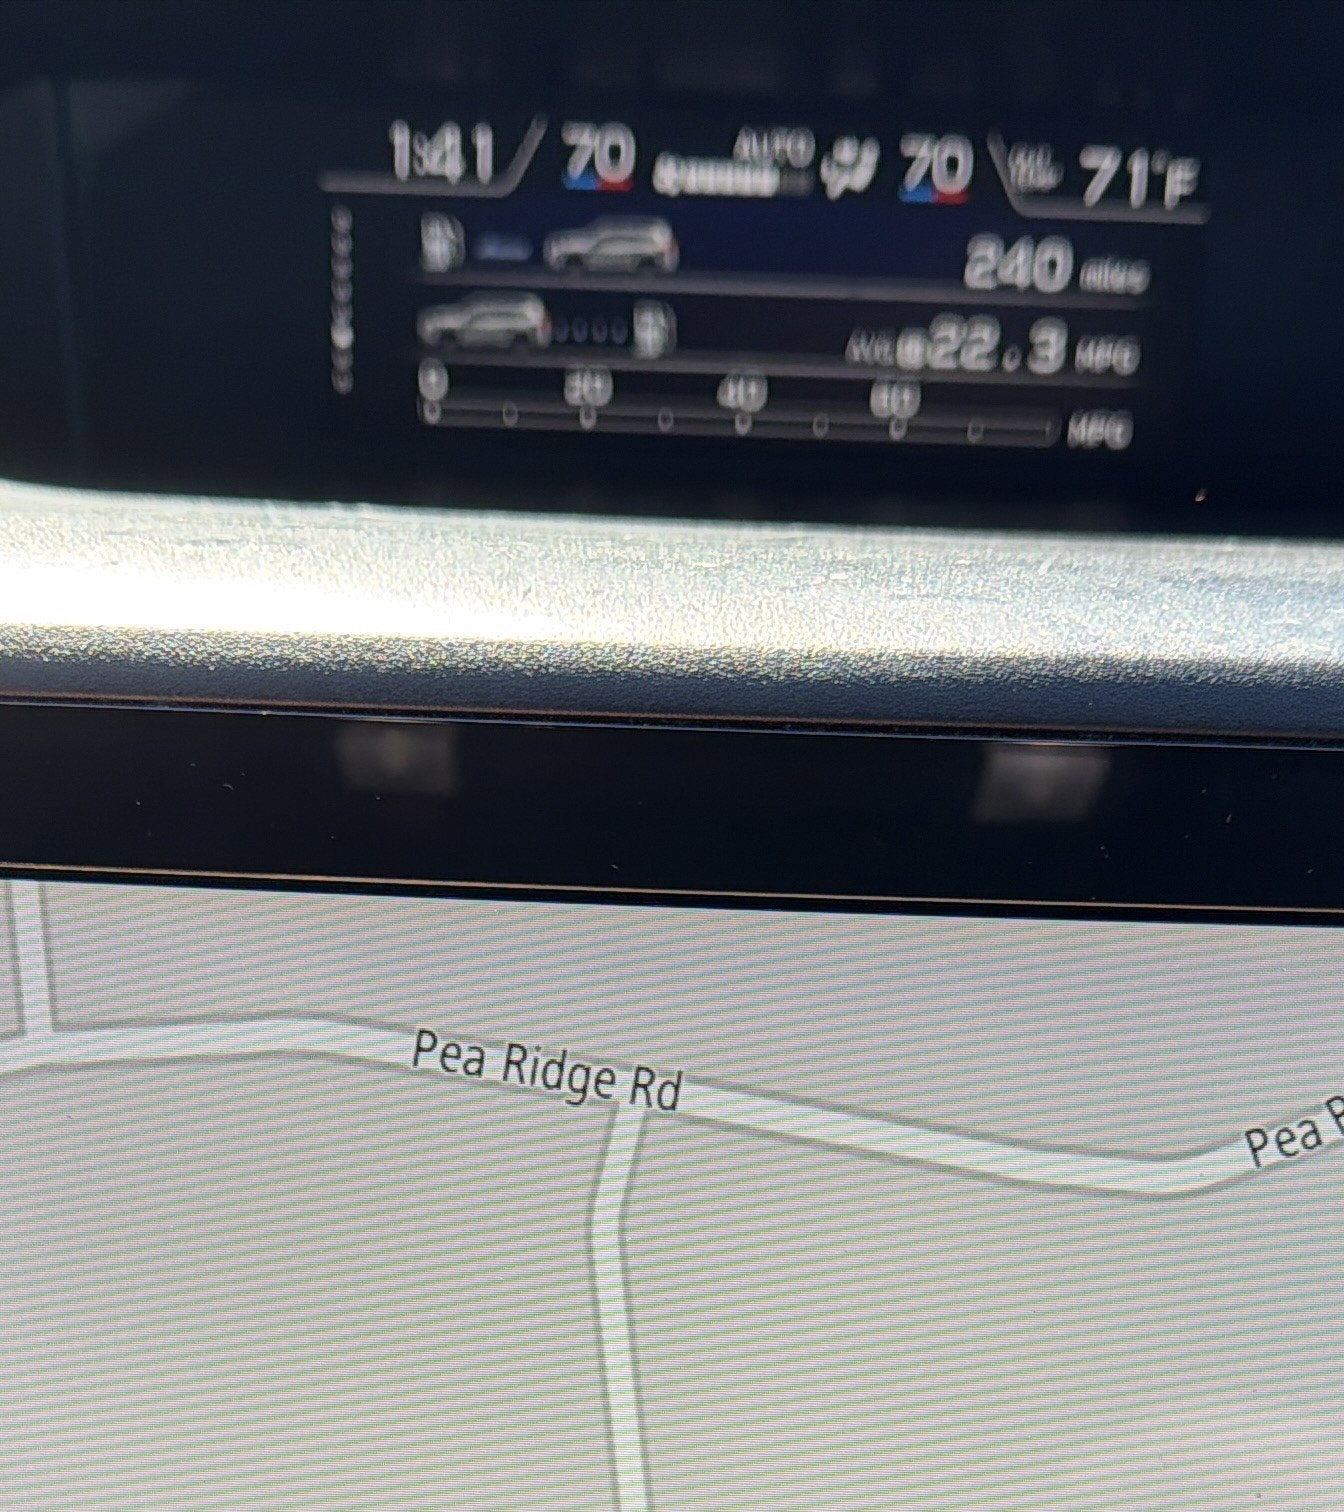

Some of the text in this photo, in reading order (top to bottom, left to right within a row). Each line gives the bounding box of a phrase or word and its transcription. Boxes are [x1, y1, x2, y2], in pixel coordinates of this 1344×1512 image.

[389, 119, 493, 185] 1:41
[561, 121, 636, 183] 70
[900, 133, 974, 195] 70
[964, 232, 1073, 293] 240
[924, 312, 1068, 374] 22.3
[413, 1029, 683, 1111] Pea Ridge Rd
[1245, 1119, 1322, 1167] Pea
